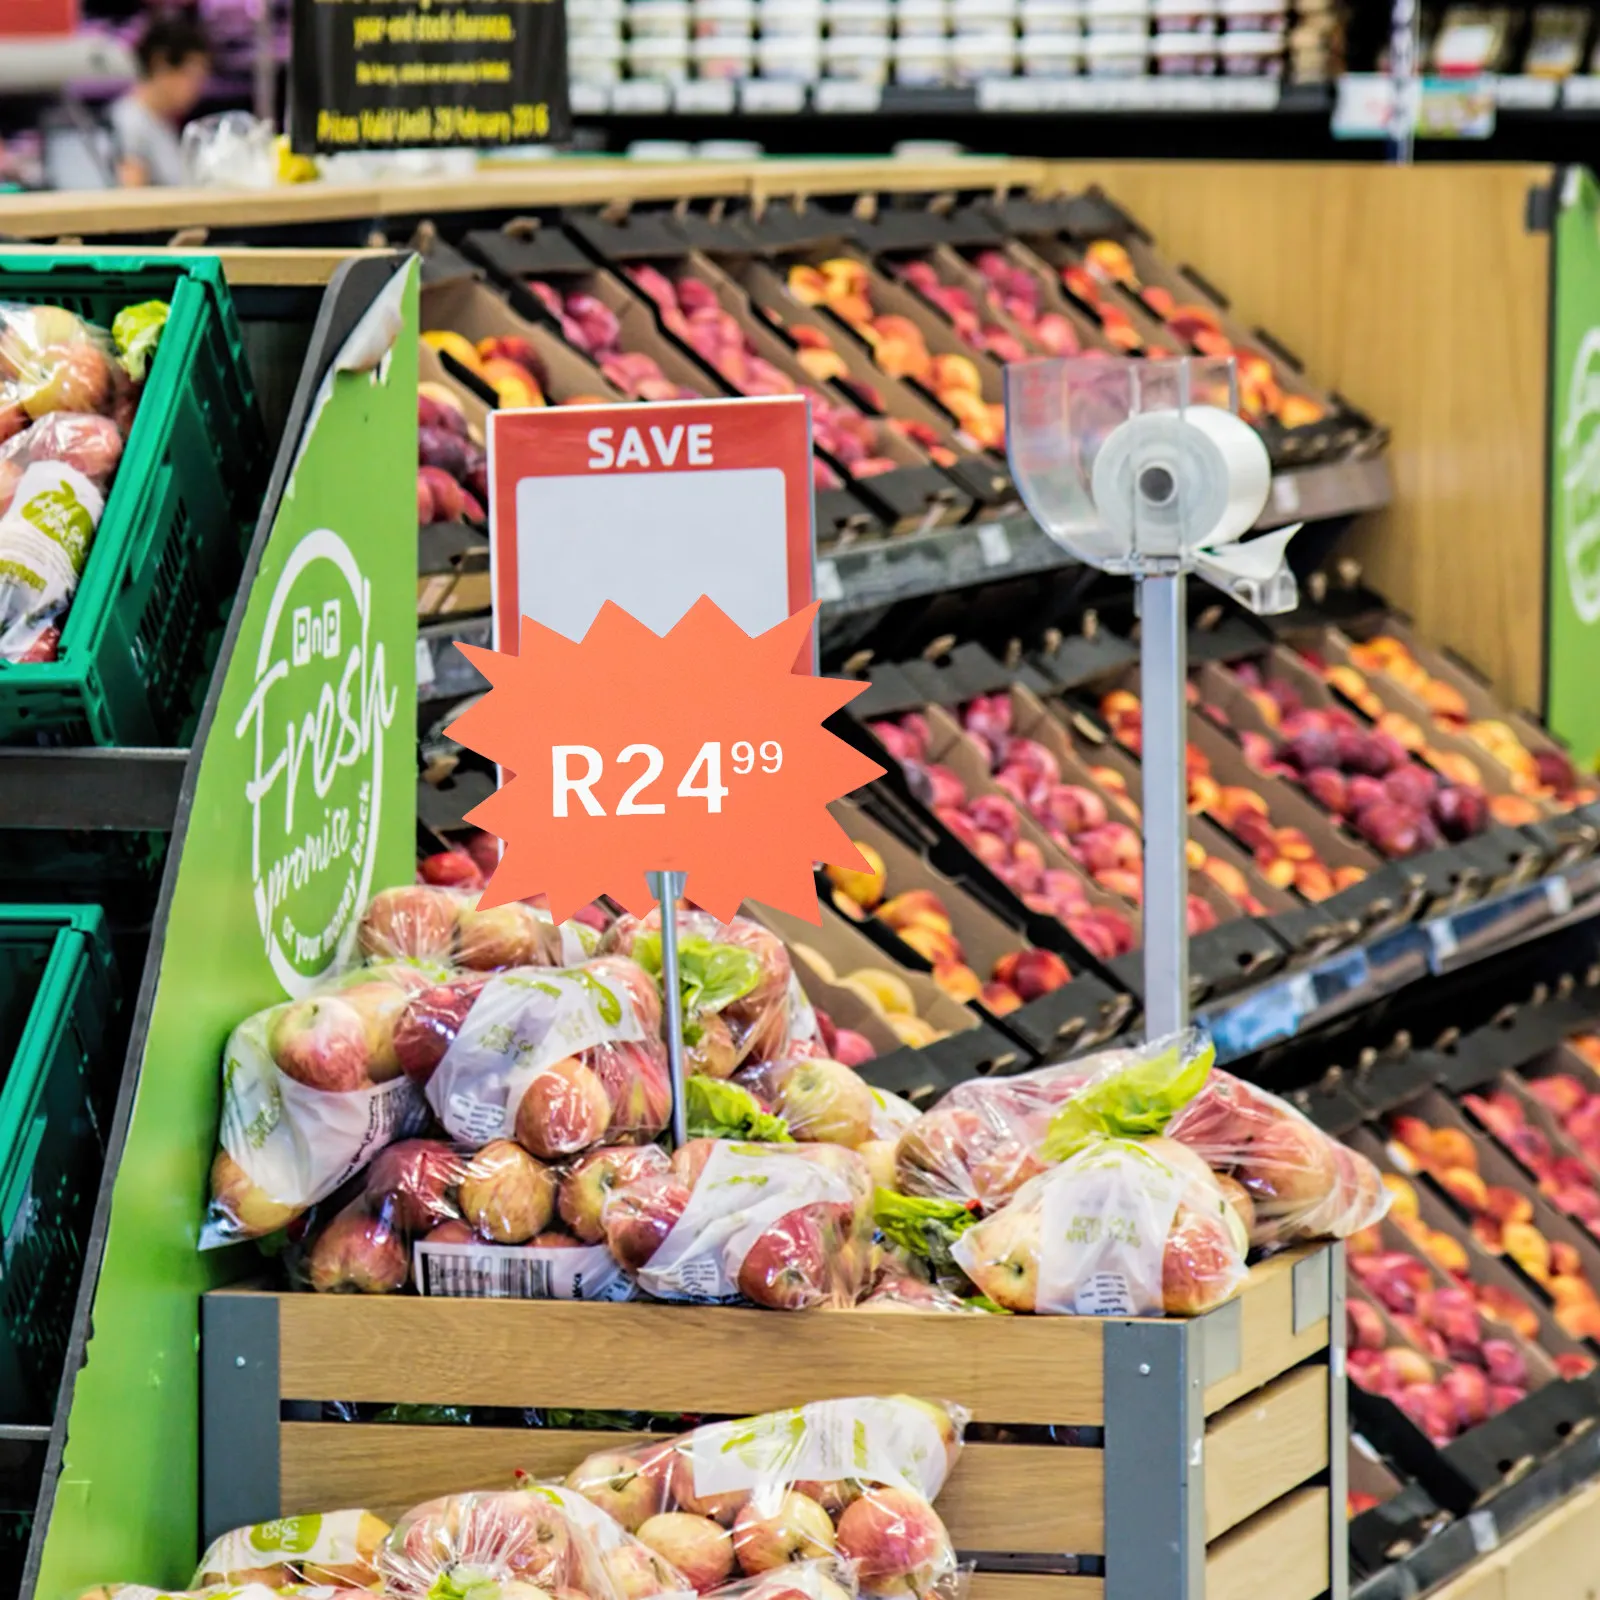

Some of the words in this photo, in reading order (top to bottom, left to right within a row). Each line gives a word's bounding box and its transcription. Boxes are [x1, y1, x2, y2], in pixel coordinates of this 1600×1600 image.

[587, 423, 714, 469] SAVE
[293, 599, 341, 667] PnP
[235, 578, 398, 836] Fresh
[264, 807, 350, 957] promise
